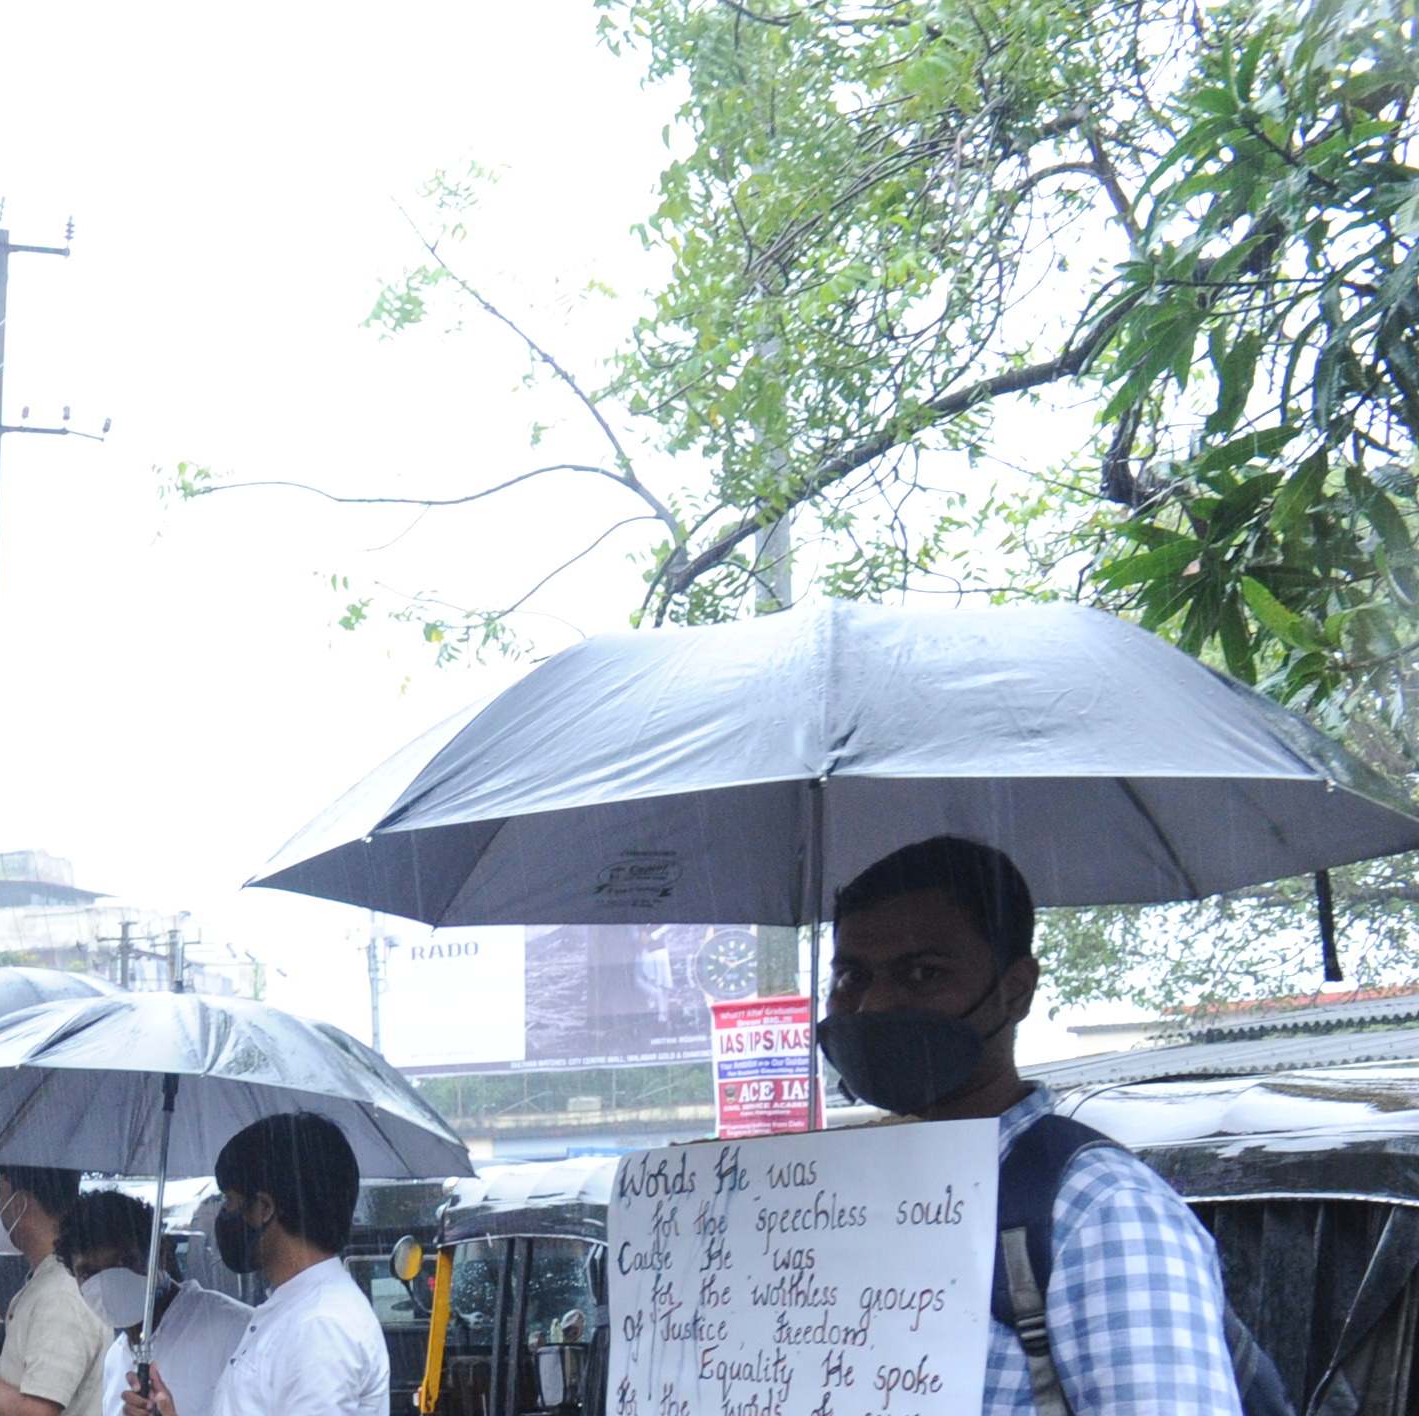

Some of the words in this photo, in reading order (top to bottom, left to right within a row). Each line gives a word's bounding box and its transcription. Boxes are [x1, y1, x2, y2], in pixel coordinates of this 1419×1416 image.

[411, 941, 479, 962] RADO
[720, 1028, 811, 1056] IAS/IPS/KAS
[739, 1080, 776, 1103] ACE
[618, 1152, 696, 1199] Words
[714, 1144, 750, 1196] He
[767, 1159, 818, 1190] was
[696, 1207, 729, 1237] the
[618, 1241, 673, 1275] Cause
[699, 1237, 734, 1273] He
[773, 1246, 816, 1275] was
[699, 1273, 731, 1305] the
[698, 1345, 793, 1401] Equality
[821, 1350, 855, 1388] He
[874, 1354, 943, 1409] spoke
